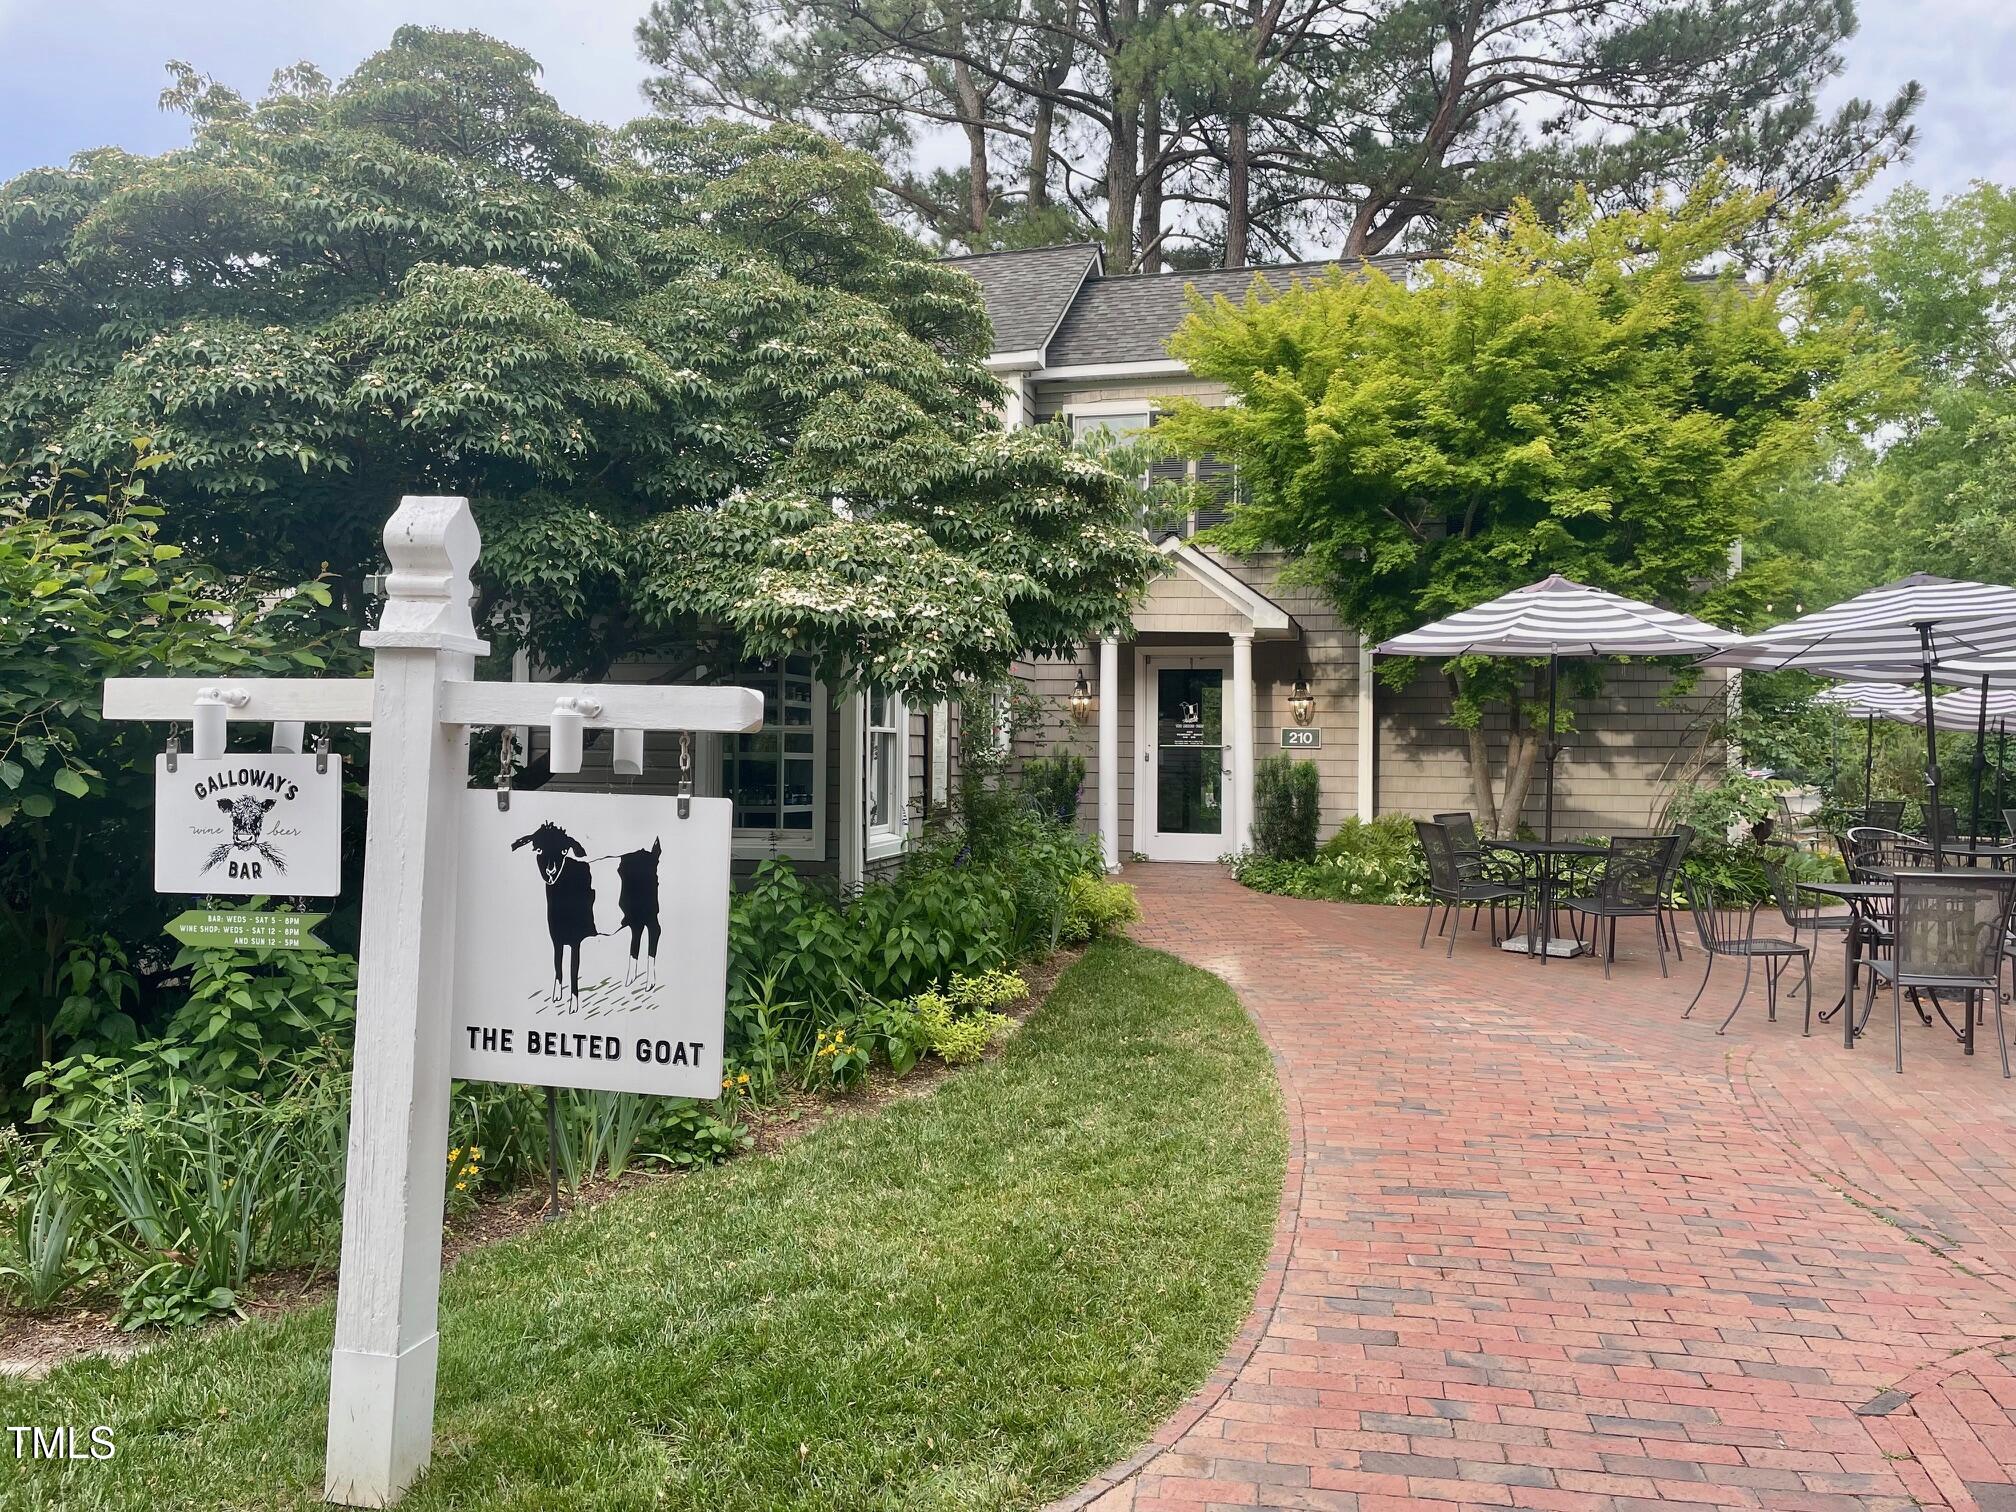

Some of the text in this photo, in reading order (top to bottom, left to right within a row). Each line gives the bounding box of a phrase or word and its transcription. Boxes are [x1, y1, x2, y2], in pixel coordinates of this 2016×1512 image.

[1289, 732, 1313, 744] 210
[194, 768, 299, 801] GALLOWAY'S
[189, 826, 224, 835] wine
[266, 820, 302, 836] beer
[228, 861, 263, 880] BAR
[179, 925, 198, 933] WINE
[199, 925, 221, 934] SHOP:
[223, 926, 244, 934] WEDS
[251, 927, 265, 935] SAT
[268, 927, 276, 935] 12
[234, 937, 249, 945] AND
[250, 938, 266, 946] SUN
[268, 938, 276, 946] 12
[284, 938, 300, 947] 5PM
[466, 1026, 705, 1068] THE BELTED GOAT
